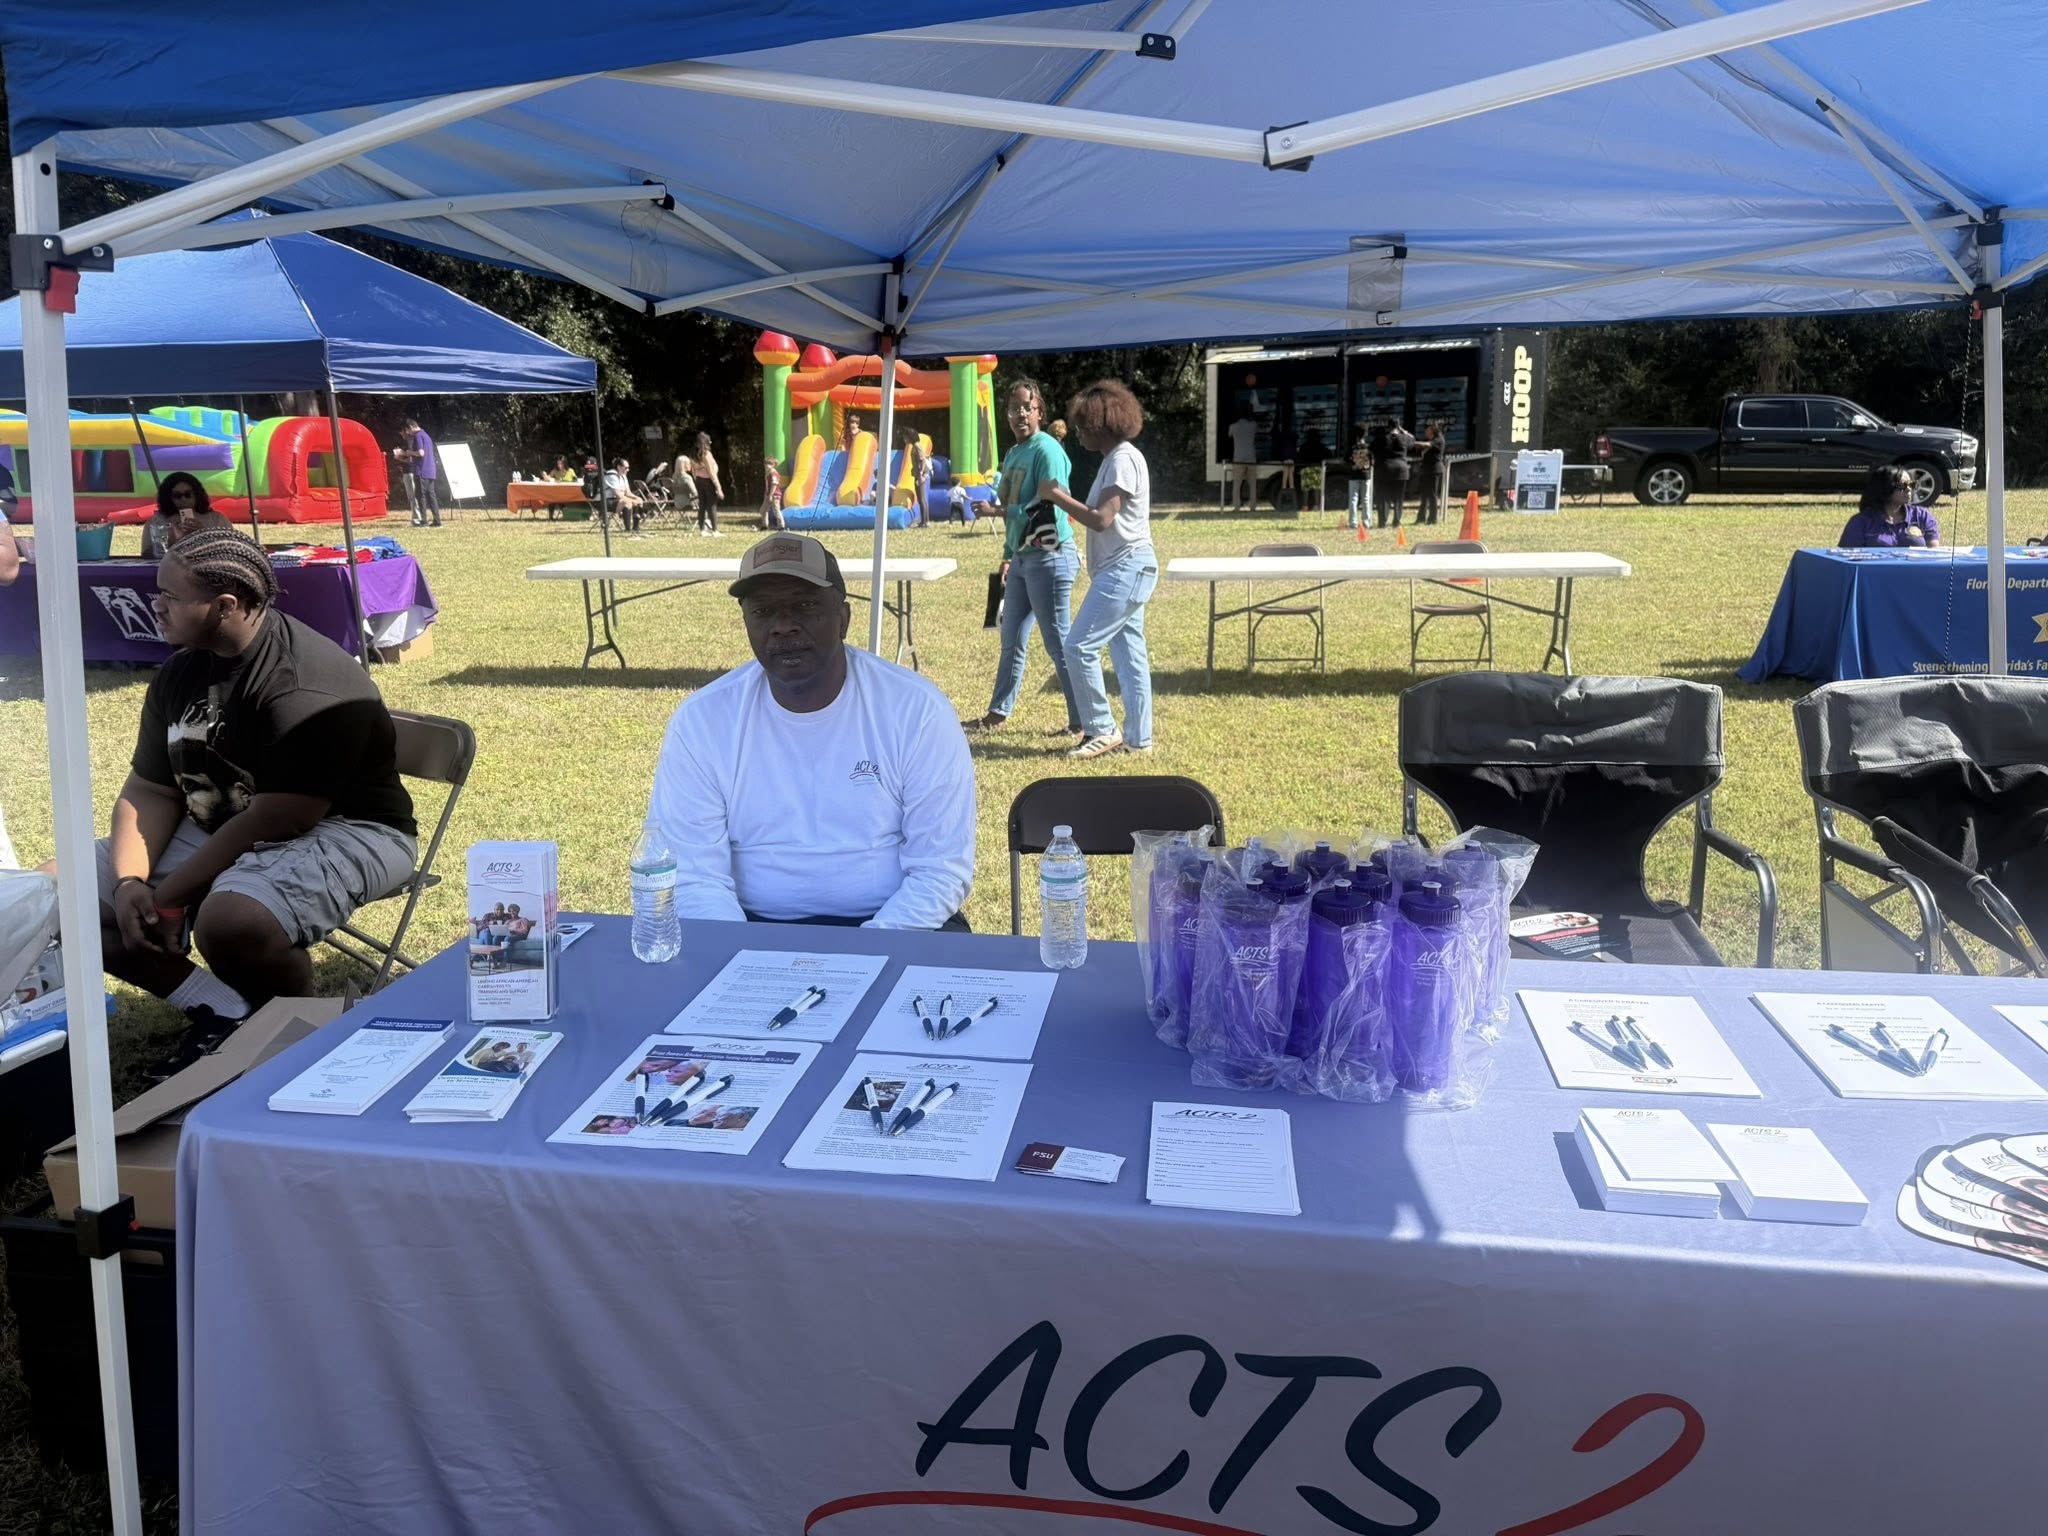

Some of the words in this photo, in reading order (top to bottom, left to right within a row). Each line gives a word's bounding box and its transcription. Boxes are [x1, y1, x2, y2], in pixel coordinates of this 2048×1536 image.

[1511, 345, 1533, 443] HOOP
[1966, 578, 1989, 590] Flor
[1912, 661, 1989, 673] Strengthening
[2006, 659, 2034, 671] rida's
[487, 862, 512, 872] ACTS
[1234, 946, 1269, 959] ACTS
[1174, 1109, 1237, 1118] ACTS
[1032, 1151, 1055, 1159] FSU
[915, 1319, 1502, 1536] ACTS
[1494, 1392, 1706, 1536] 2
